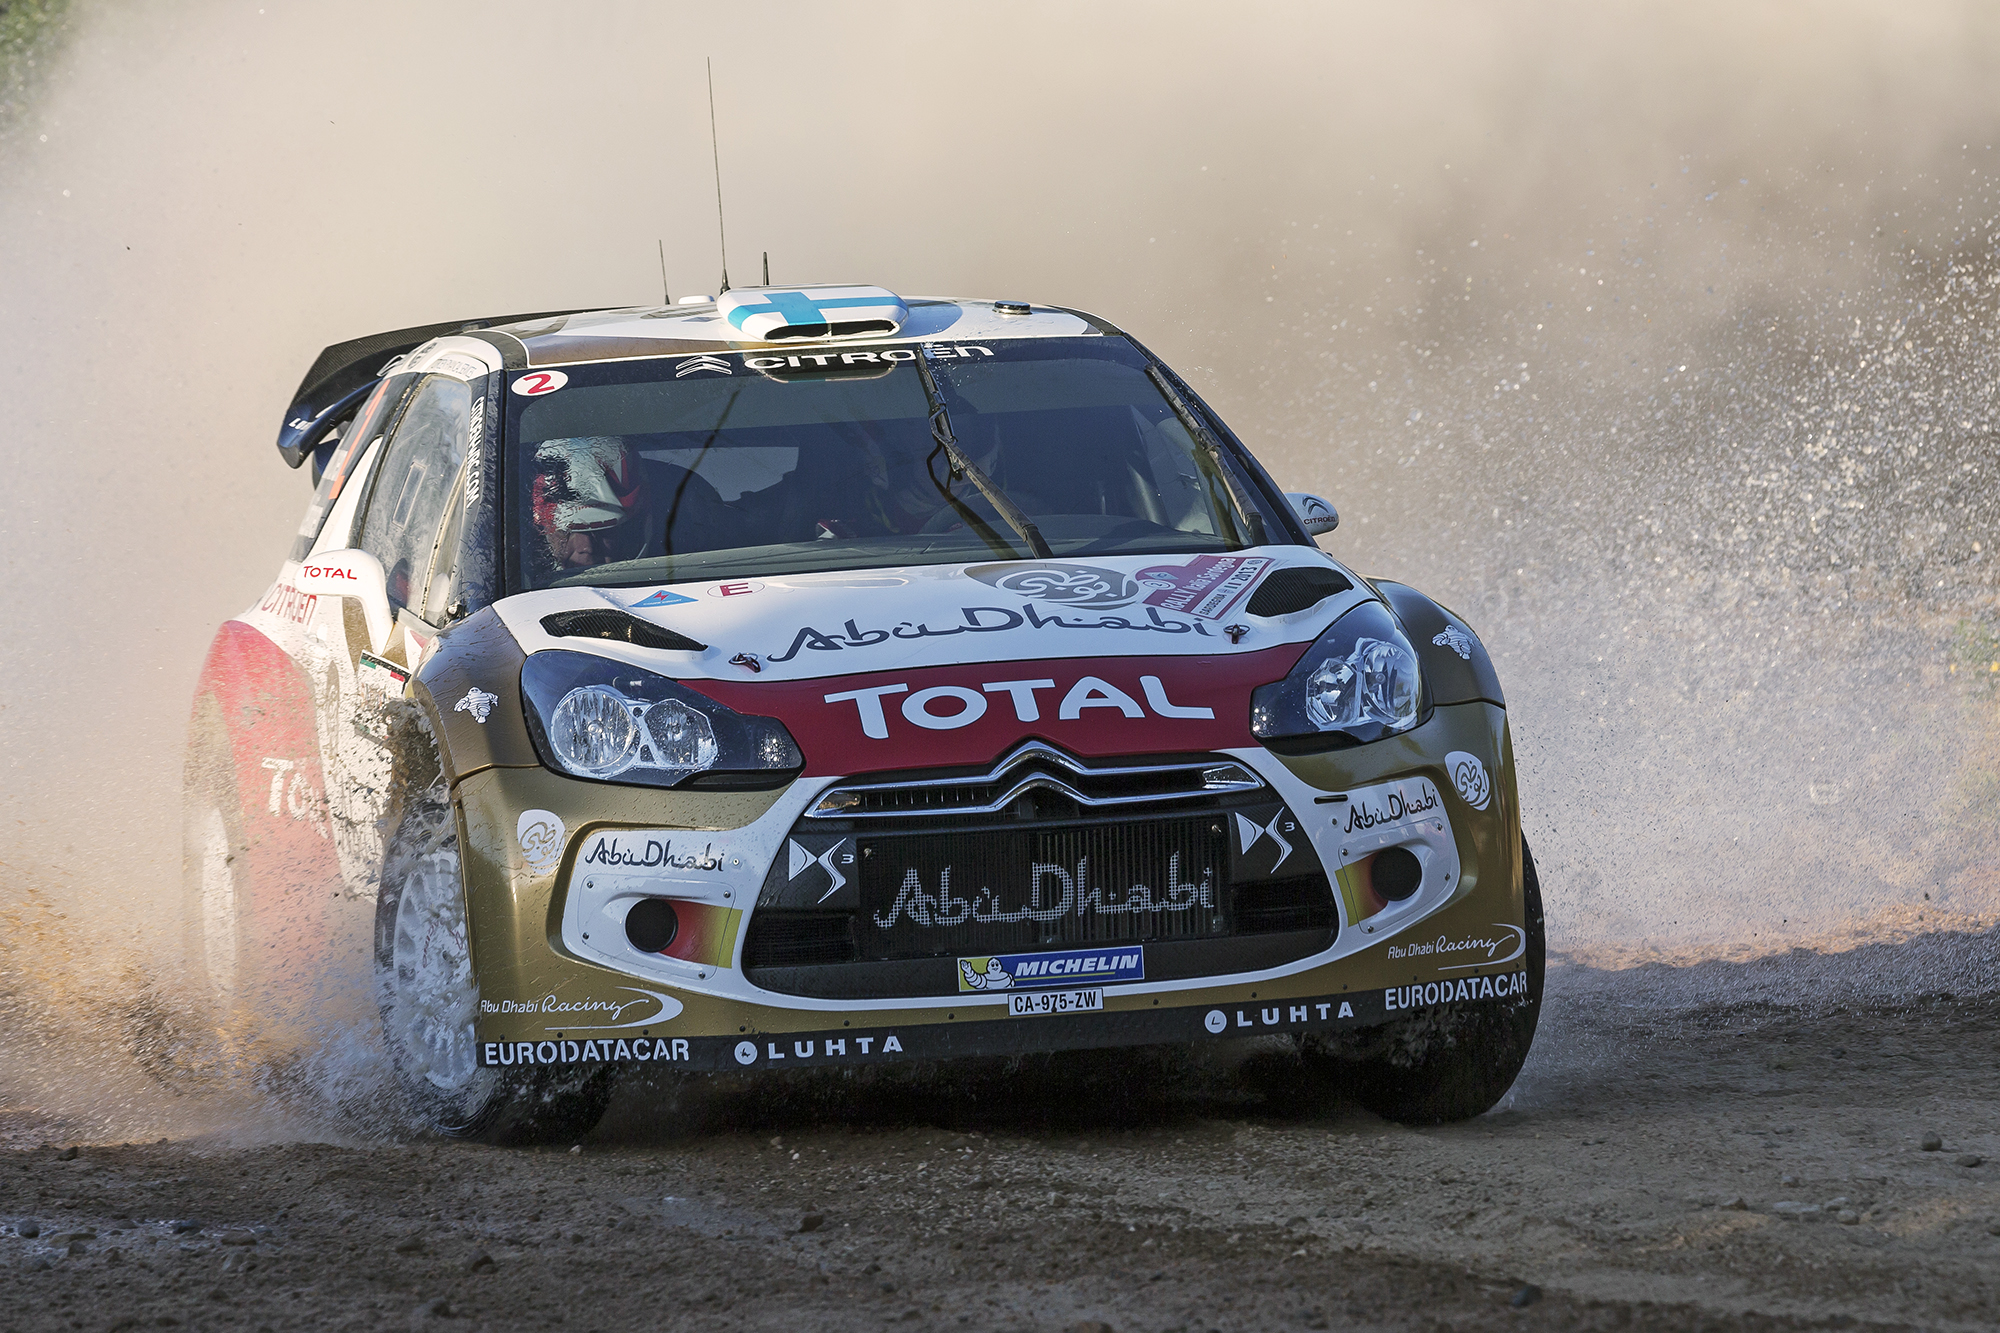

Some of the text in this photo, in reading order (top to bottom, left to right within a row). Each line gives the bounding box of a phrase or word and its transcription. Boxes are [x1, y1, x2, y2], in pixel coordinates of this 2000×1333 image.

[523, 373, 555, 394] 2
[303, 565, 357, 580] TOTAL
[1231, 566, 1258, 581] 2013
[719, 582, 753, 597] E
[1160, 588, 1198, 610] RALLY
[823, 675, 1216, 740] TOTAL
[1388, 934, 1515, 959] Abu Dhabi Racing
[1014, 954, 1139, 976] MICHELIN
[1014, 991, 1097, 1013] CA-975-ZW
[1385, 971, 1528, 1011] EURODATACAR
[480, 994, 650, 1020] Abu Dhabi Racing
[1237, 1001, 1354, 1027] LUHTA
[485, 1038, 690, 1065] EURODATACAR
[768, 1035, 903, 1059] LUHTA
